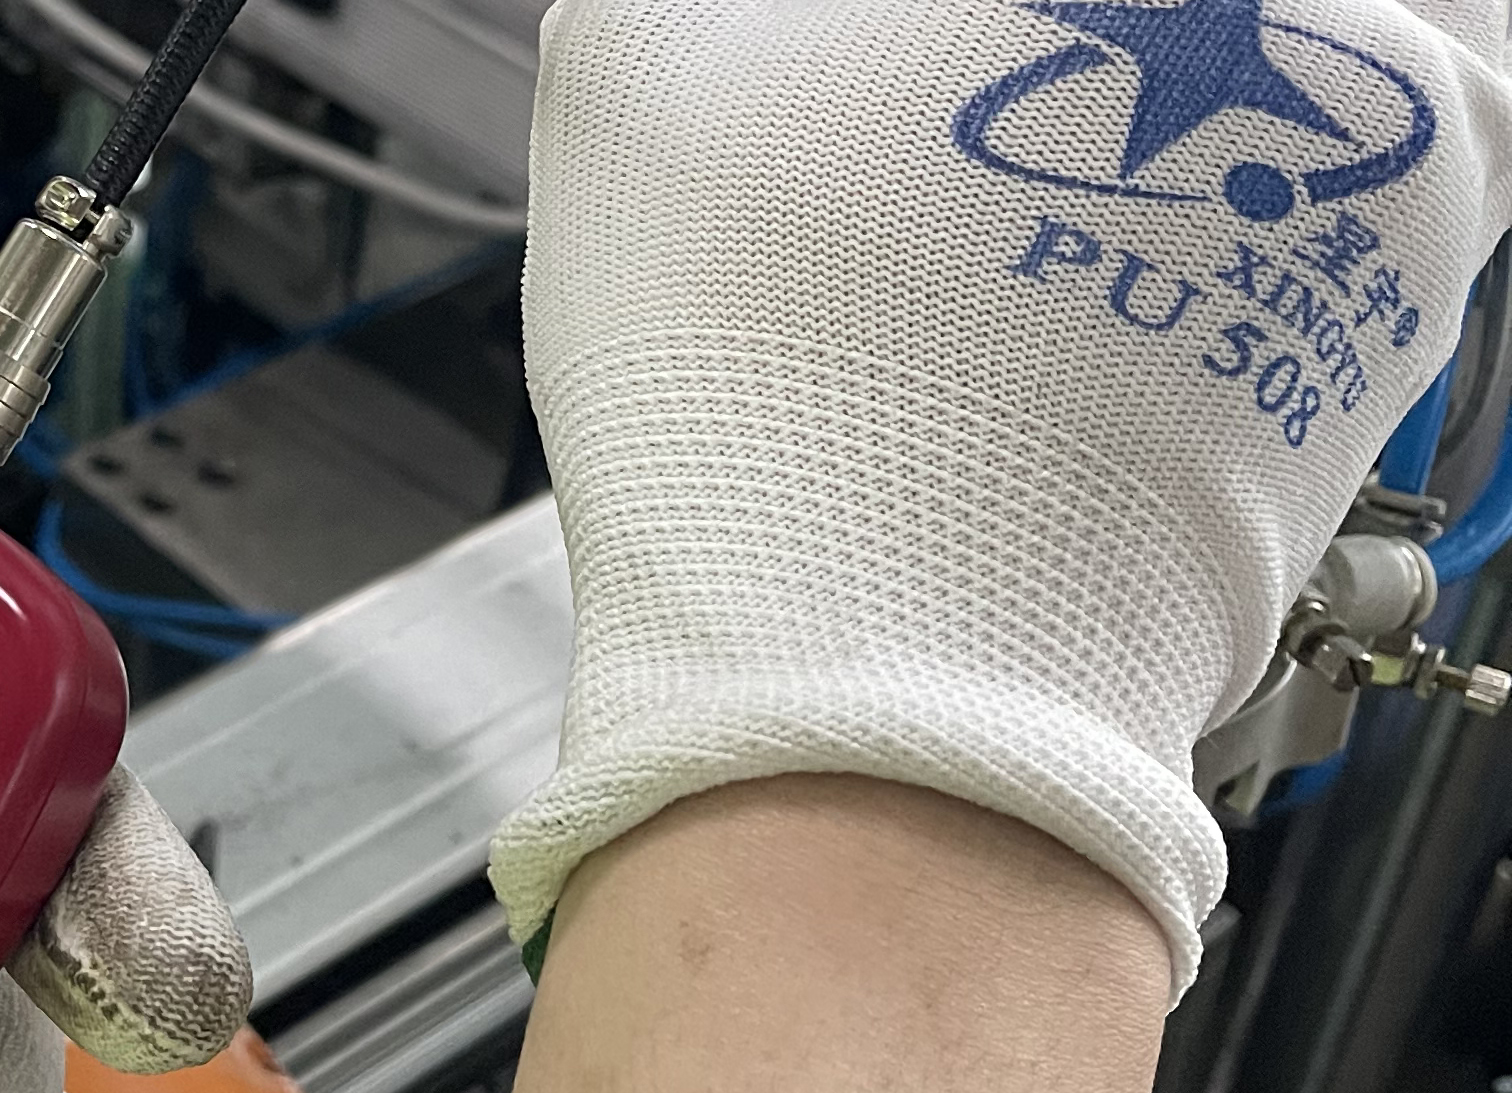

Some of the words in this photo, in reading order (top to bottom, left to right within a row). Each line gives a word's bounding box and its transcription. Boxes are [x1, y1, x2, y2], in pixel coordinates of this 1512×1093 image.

[1007, 216, 1211, 332] PU
[1201, 321, 1321, 449] 508
[1216, 241, 1368, 412] XINGYU
